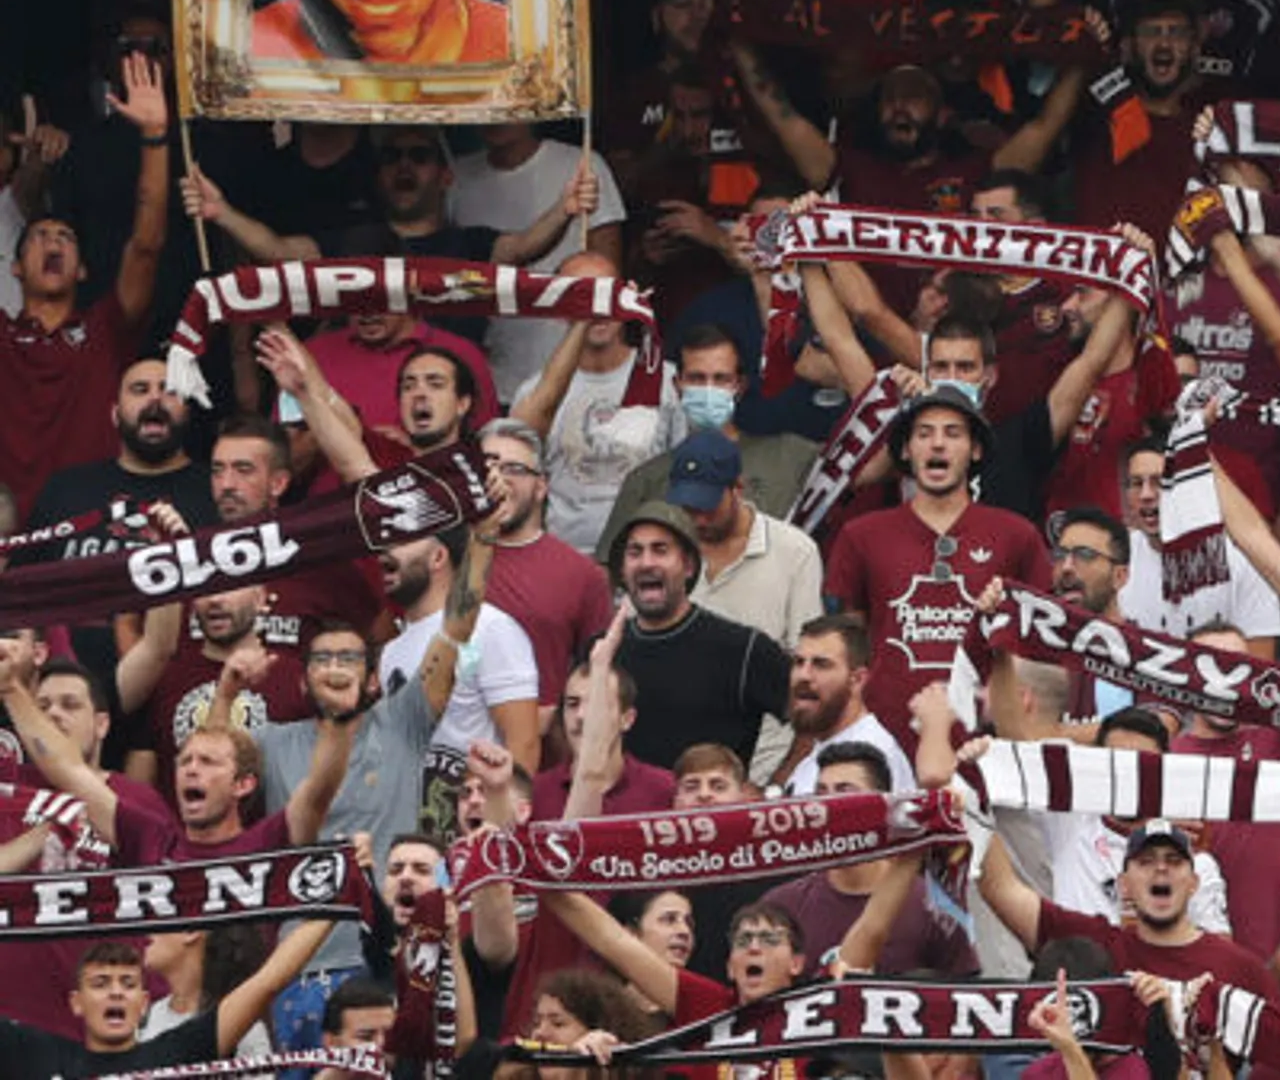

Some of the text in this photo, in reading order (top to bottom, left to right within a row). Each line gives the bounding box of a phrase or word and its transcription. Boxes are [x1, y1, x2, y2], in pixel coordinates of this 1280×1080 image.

[639, 802, 829, 846] 1919 2019
[640, 850, 724, 879] Secolo
[729, 842, 757, 869] di
[761, 830, 878, 865] Passione
